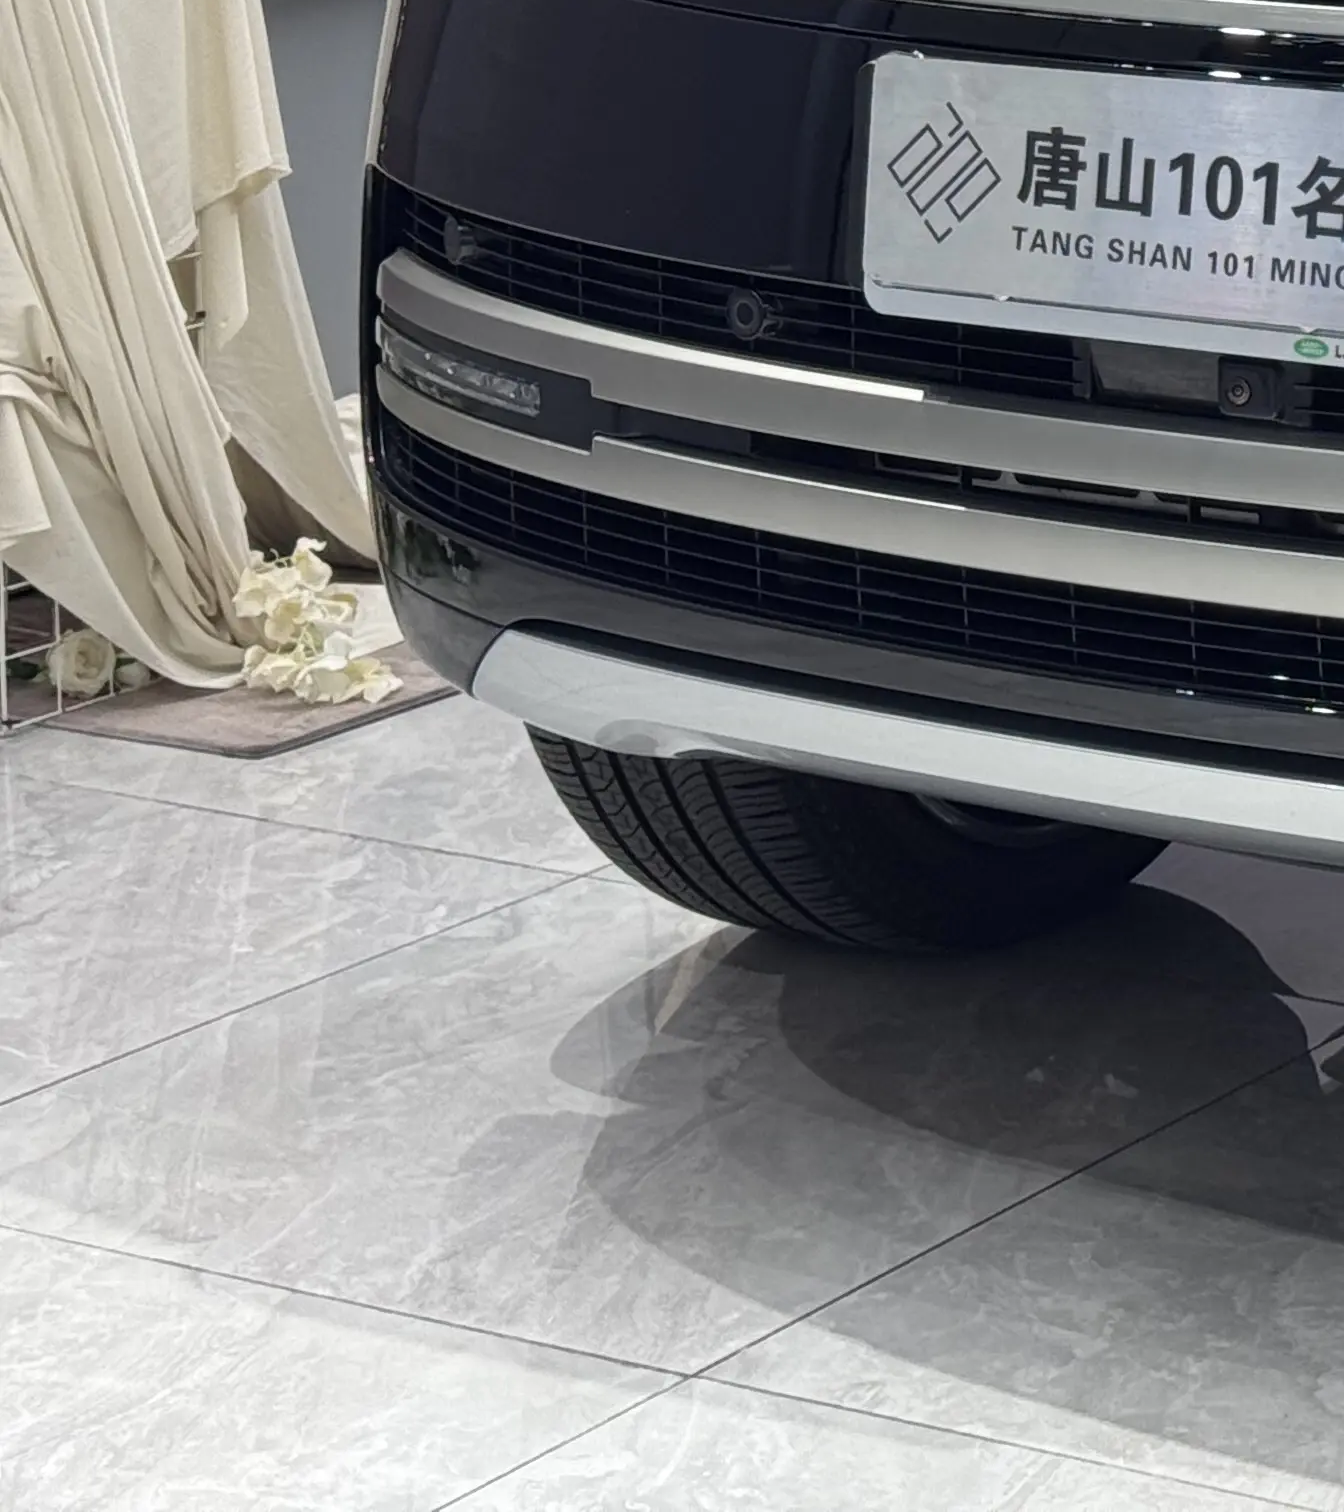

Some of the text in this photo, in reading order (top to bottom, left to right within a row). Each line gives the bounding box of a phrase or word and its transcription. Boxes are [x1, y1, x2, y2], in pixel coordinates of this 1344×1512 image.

[1012, 225, 1095, 259] TANG
[1107, 238, 1192, 272] SHAN
[1208, 251, 1255, 278] 101
